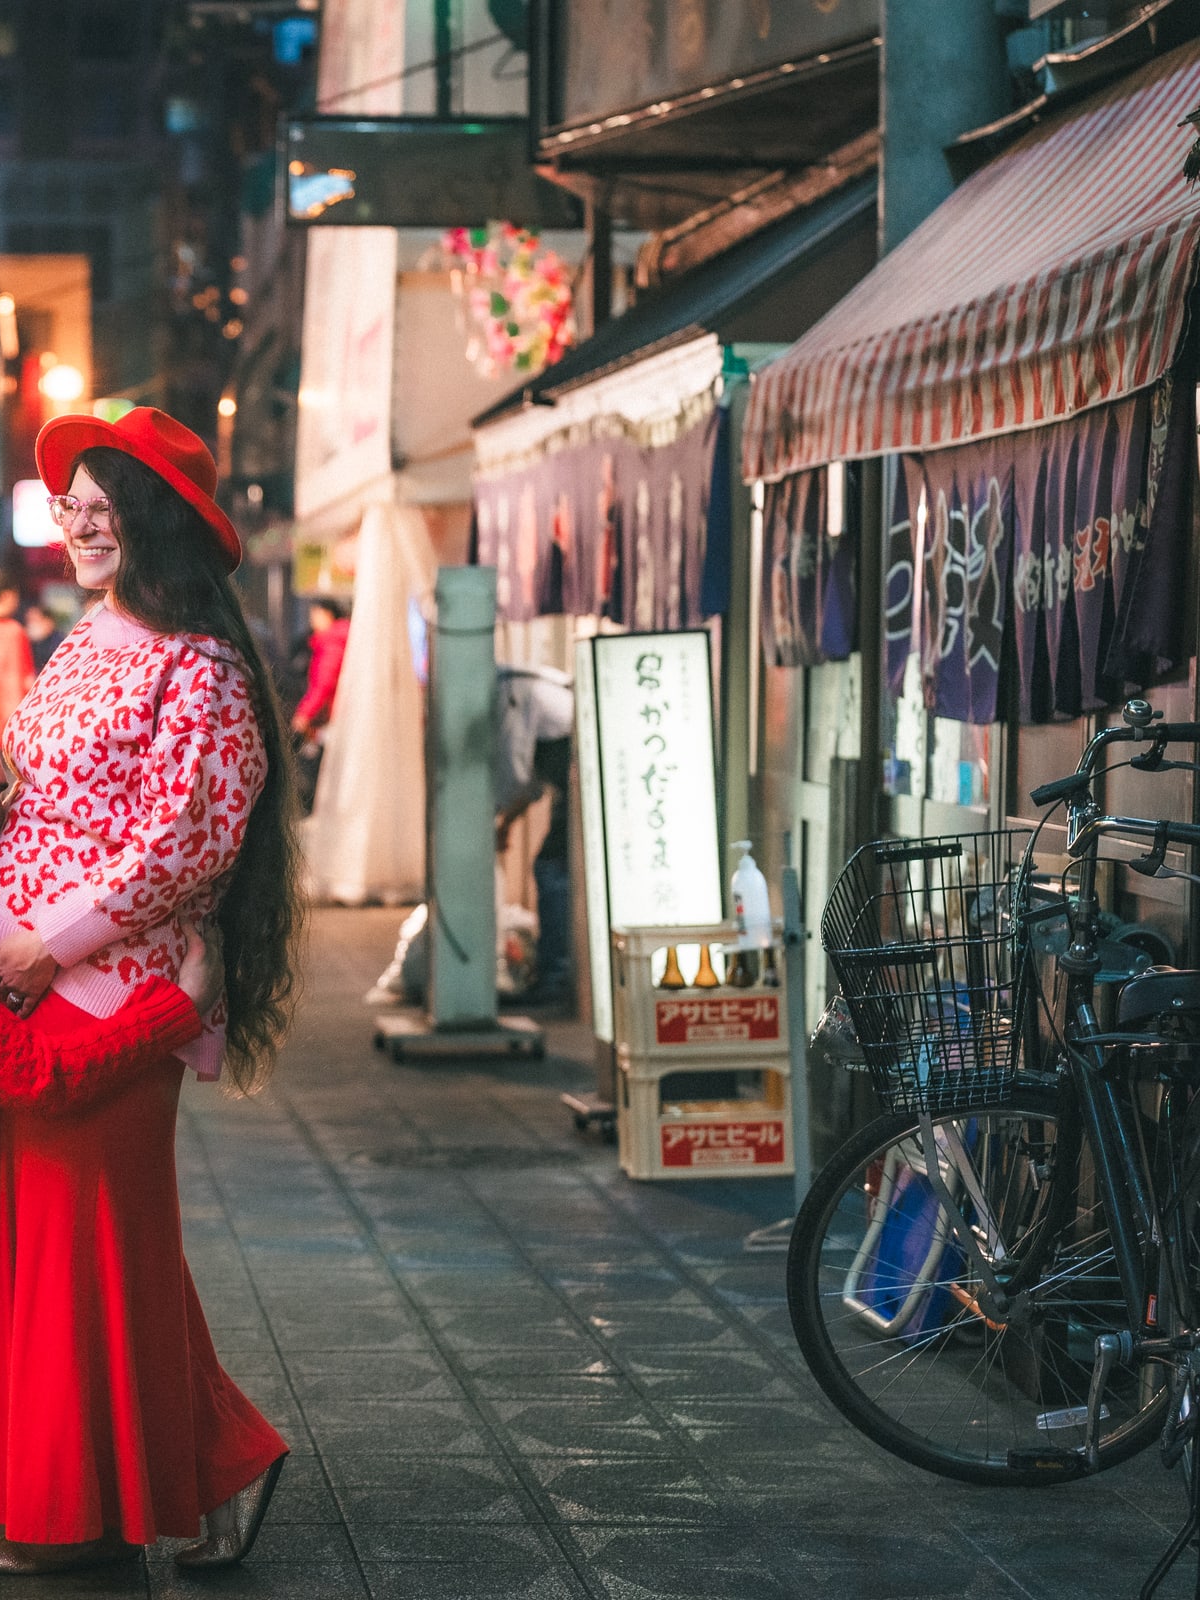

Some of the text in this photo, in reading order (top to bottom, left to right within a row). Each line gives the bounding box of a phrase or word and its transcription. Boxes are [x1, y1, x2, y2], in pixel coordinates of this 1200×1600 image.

[660, 1001, 776, 1026] アサヒビール
[665, 1125, 781, 1148] アサヒビール
